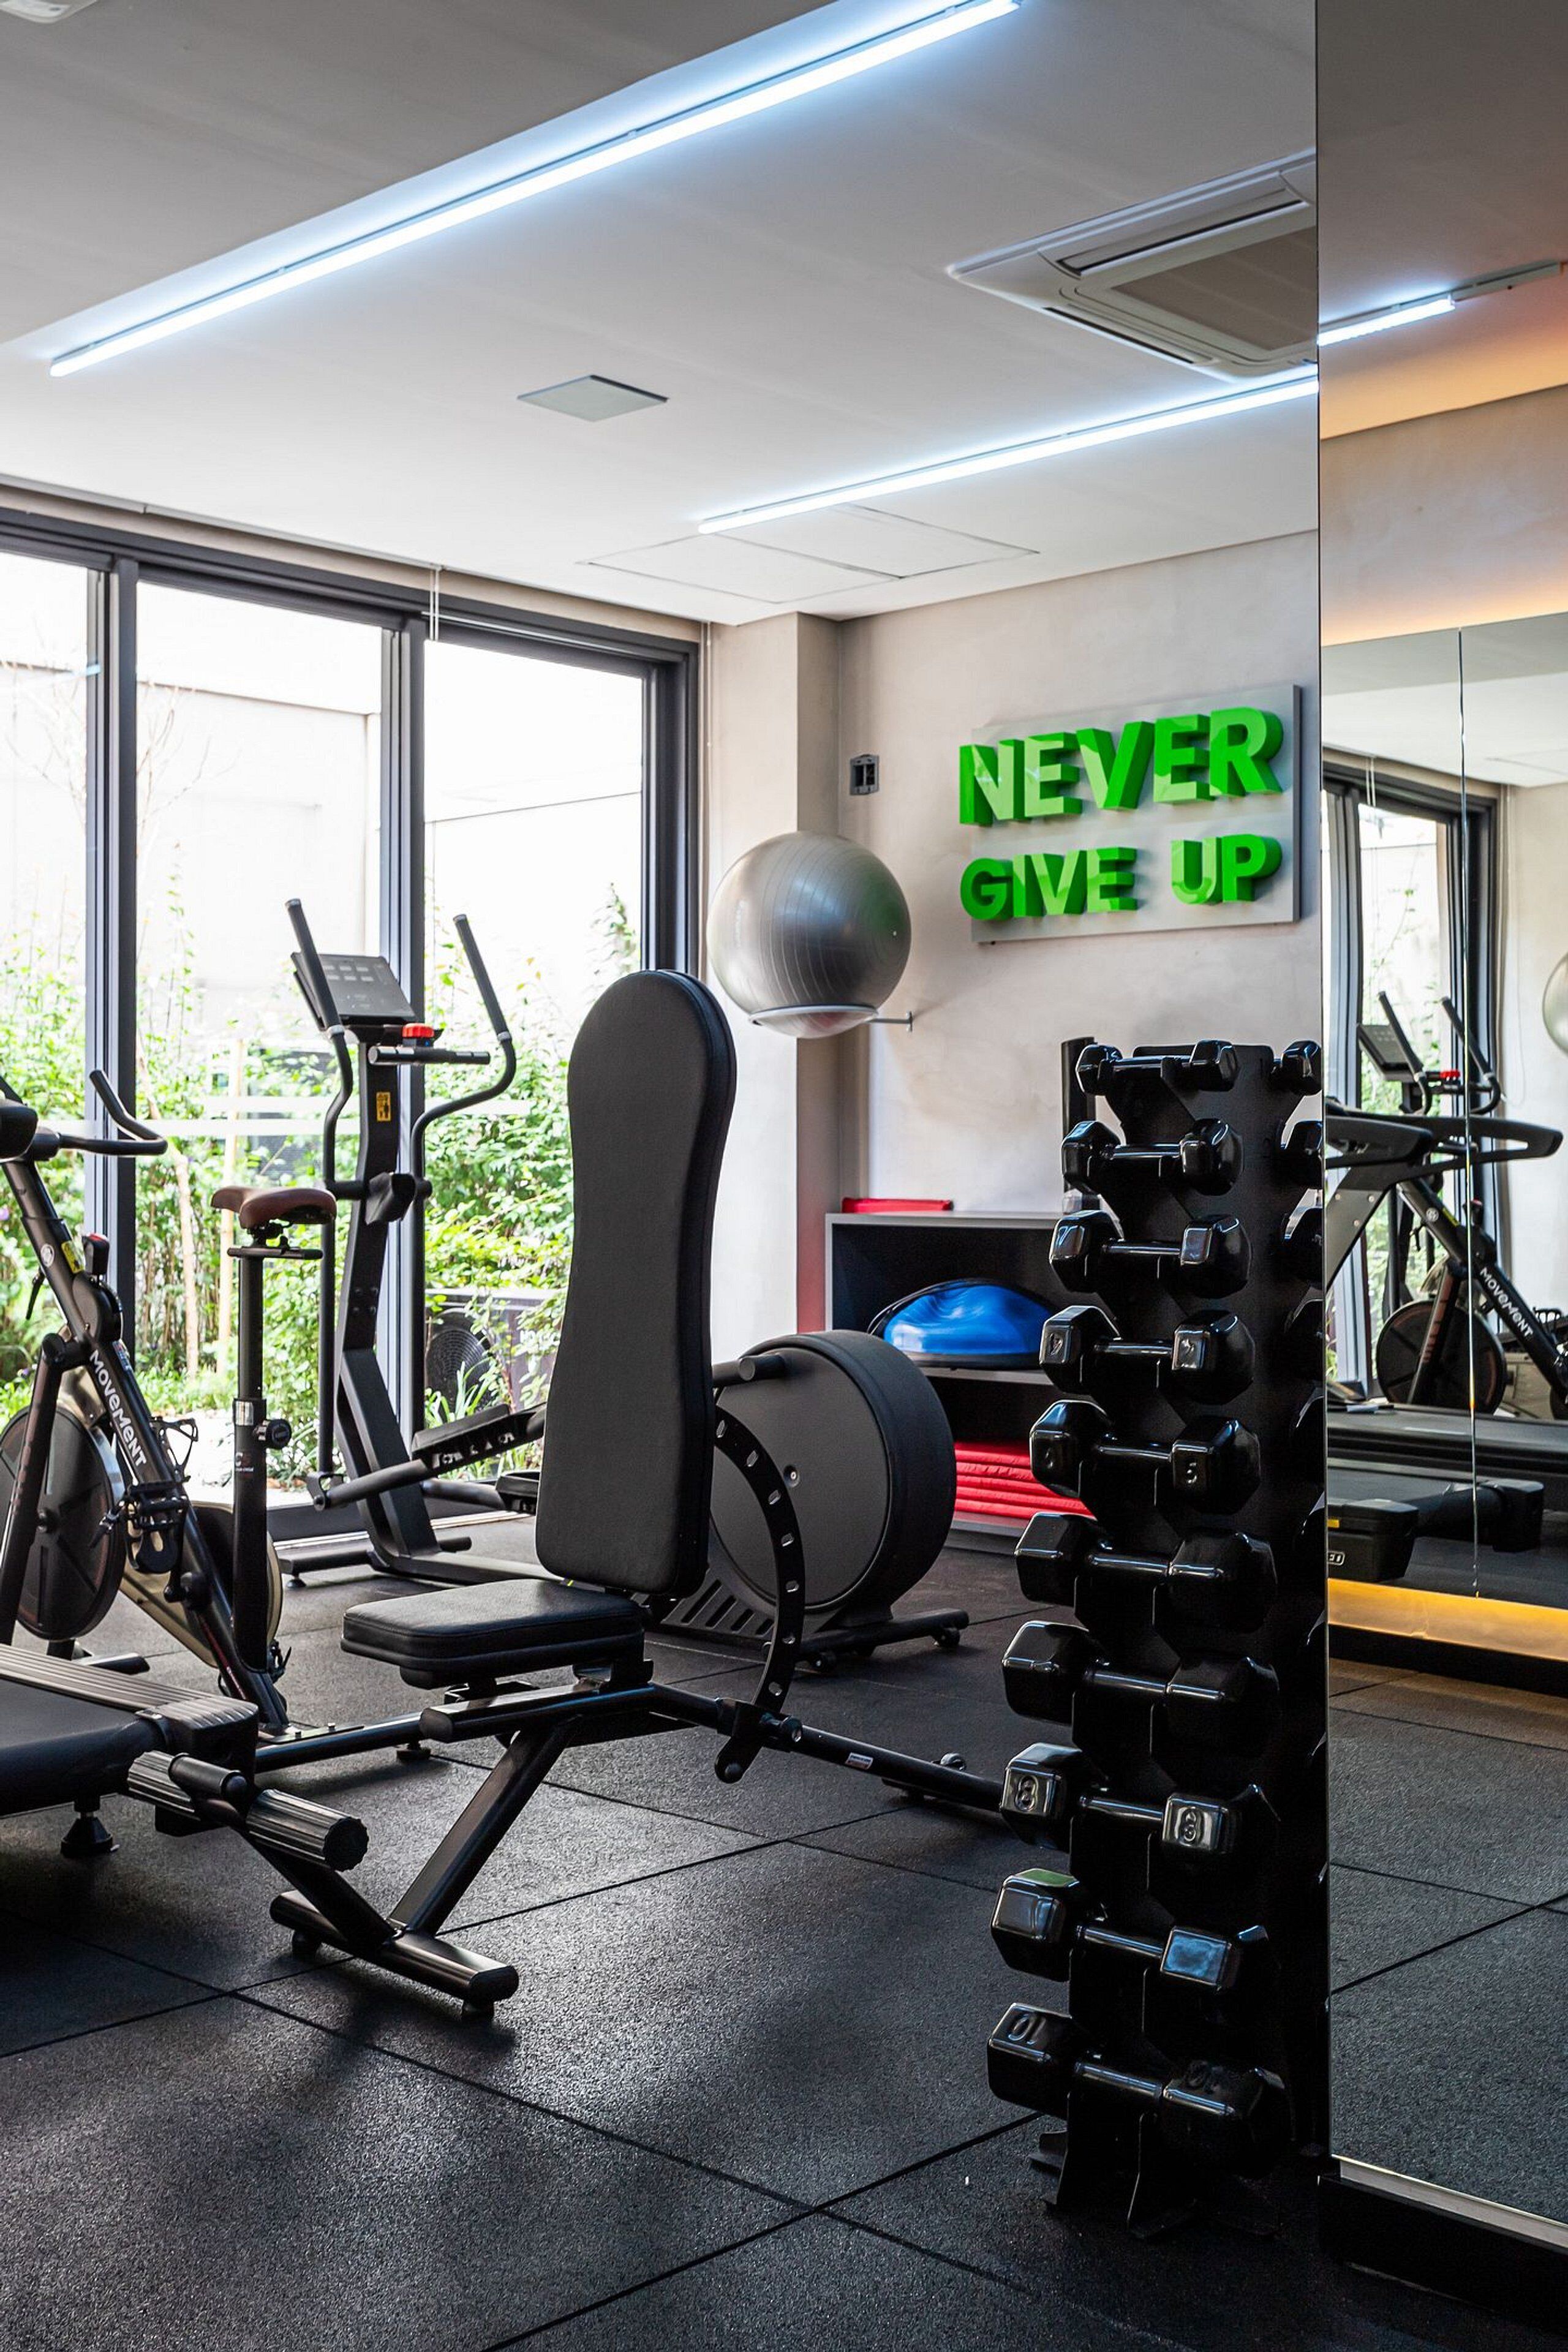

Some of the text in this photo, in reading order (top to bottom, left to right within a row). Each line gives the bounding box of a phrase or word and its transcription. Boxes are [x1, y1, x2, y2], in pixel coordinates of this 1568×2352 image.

[959, 706, 1284, 826] NEVER
[960, 834, 1283, 921] GIVE UP
[1014, 1775, 1039, 1812] 8
